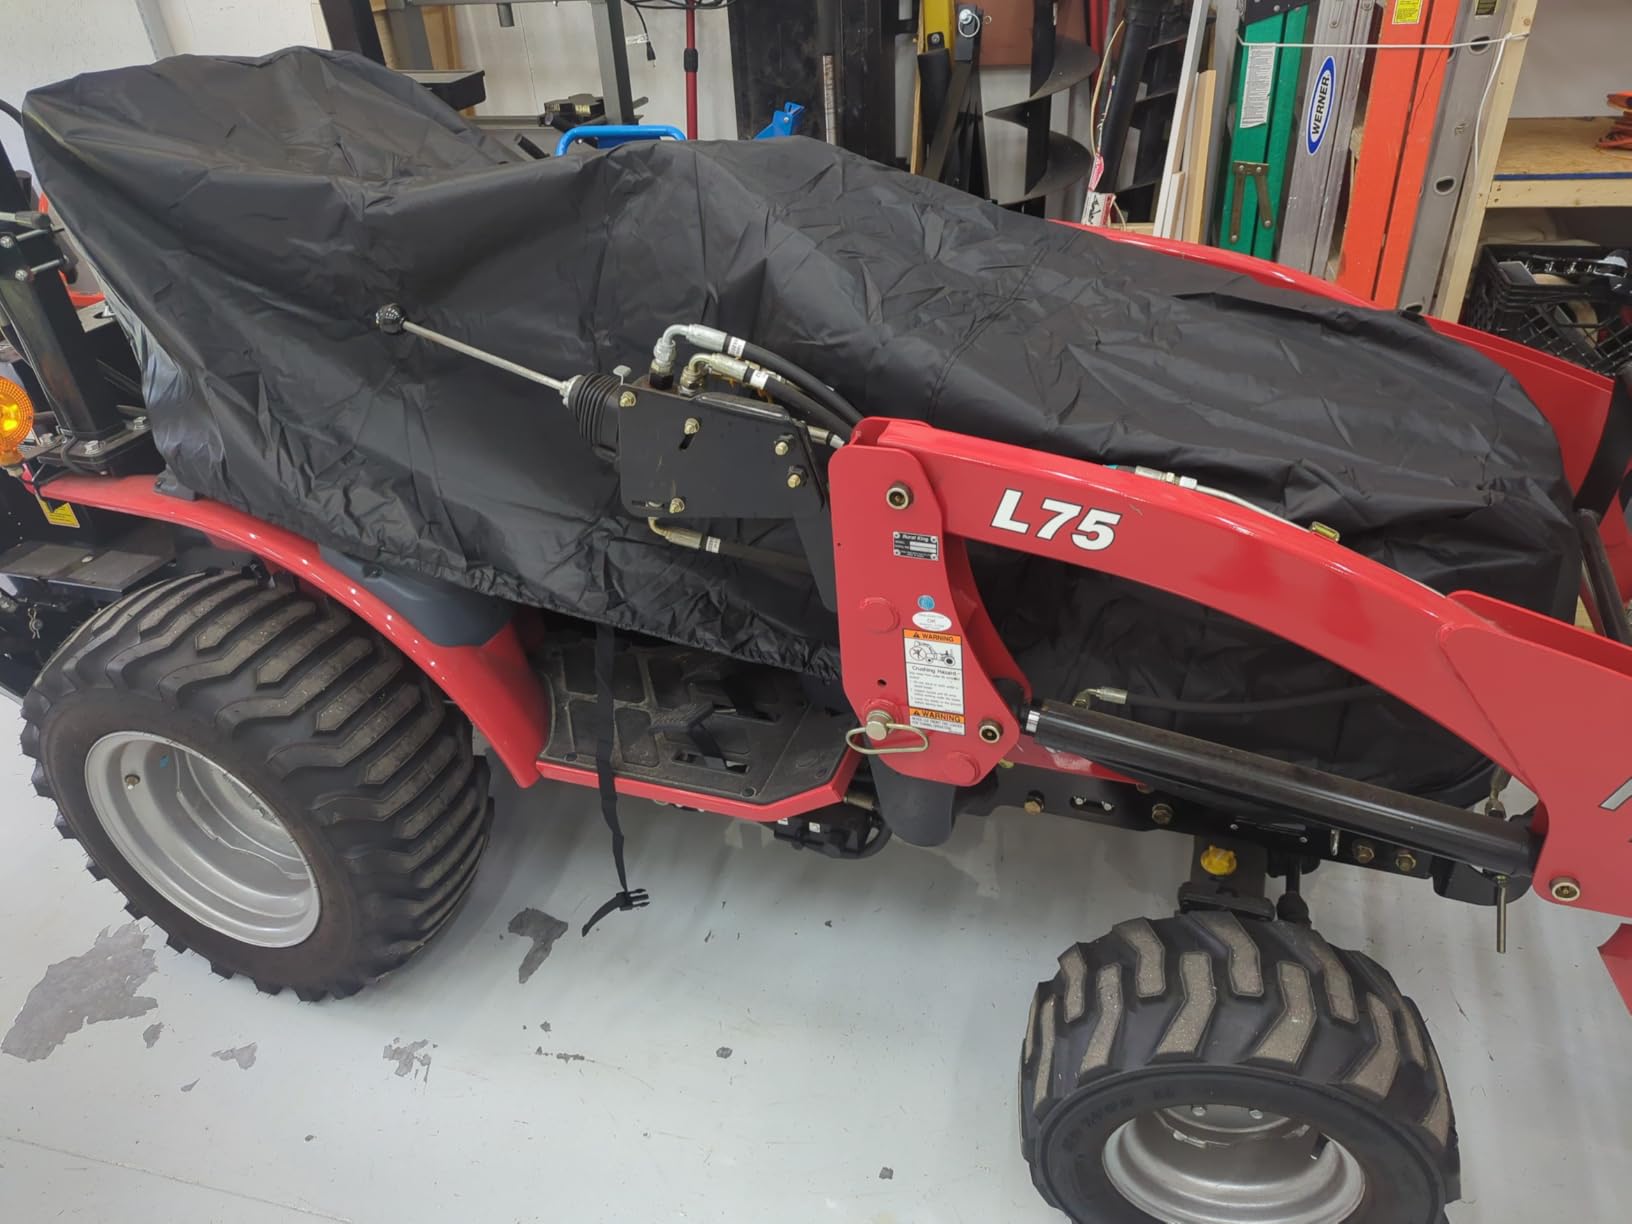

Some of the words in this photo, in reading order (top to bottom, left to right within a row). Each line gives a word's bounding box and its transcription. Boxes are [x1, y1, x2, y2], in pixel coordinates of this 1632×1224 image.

[1311, 76, 1330, 135] WERNER
[990, 488, 1123, 551] L75
[921, 633, 954, 642] WARNING
[912, 665, 936, 674] Crushing
[921, 710, 961, 722] WARNING
